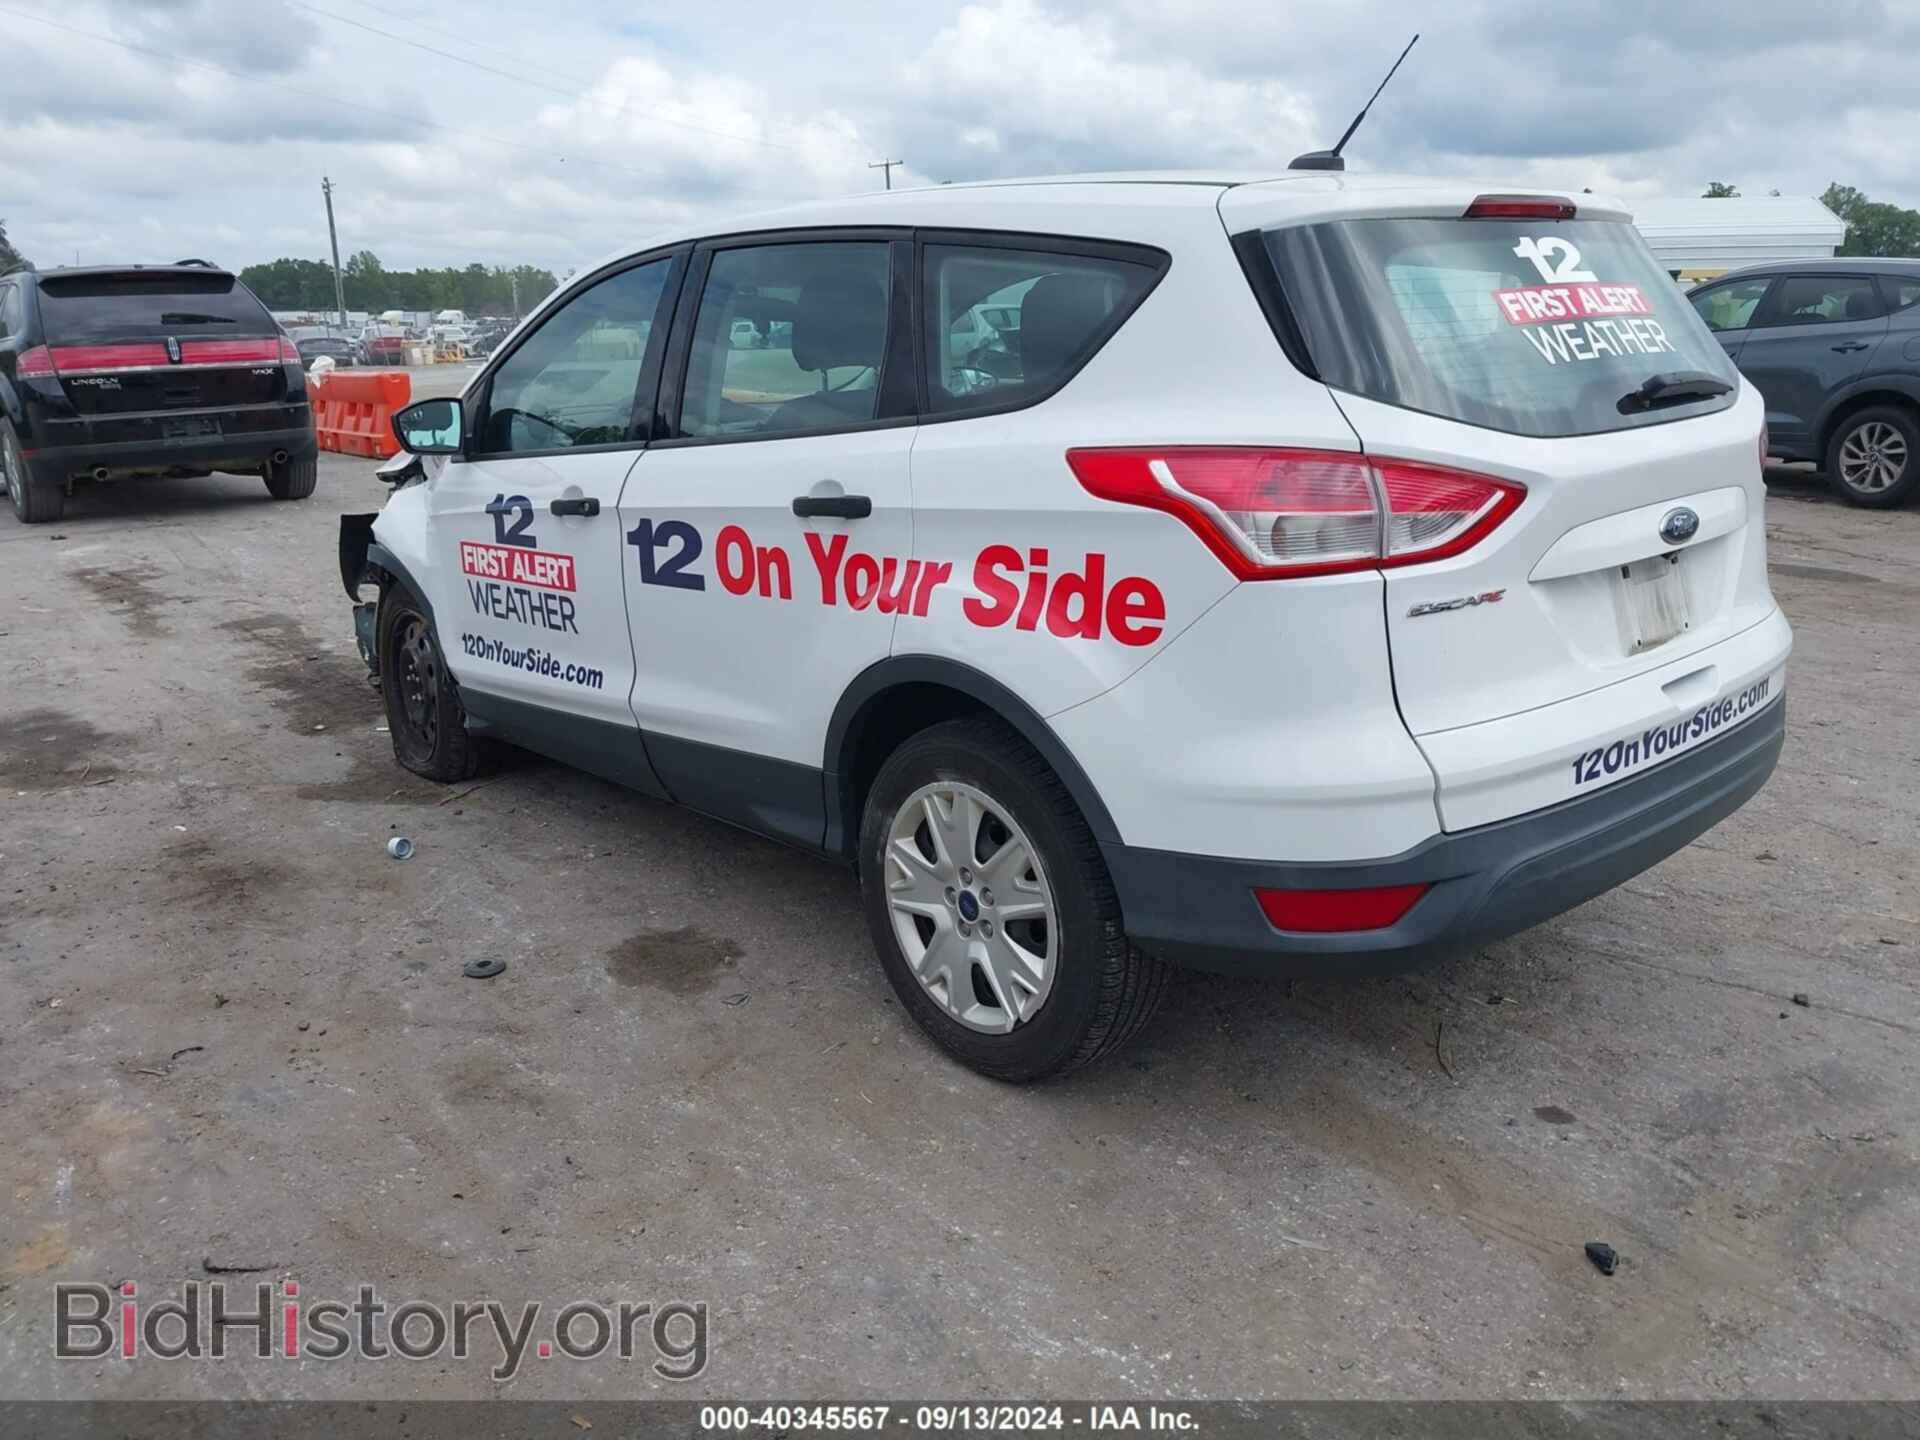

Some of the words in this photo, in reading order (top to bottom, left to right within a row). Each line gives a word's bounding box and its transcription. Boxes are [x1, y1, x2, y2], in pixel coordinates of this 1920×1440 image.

[1512, 236, 1598, 283] 12
[1500, 289, 1577, 320] FIRST
[1577, 287, 1648, 314] ALERT
[1521, 319, 1675, 364] WEATHER
[485, 493, 537, 549] 12
[463, 545, 510, 577] FIRST
[513, 555, 571, 588] ALERT
[627, 518, 705, 591] 12
[716, 525, 792, 600] On
[804, 532, 953, 617] Your
[963, 544, 1166, 647] Side
[467, 578, 579, 634] WEATHER
[462, 632, 603, 689] 12OnYourSide.com
[1572, 675, 1770, 784] 12OnYourSide.com
